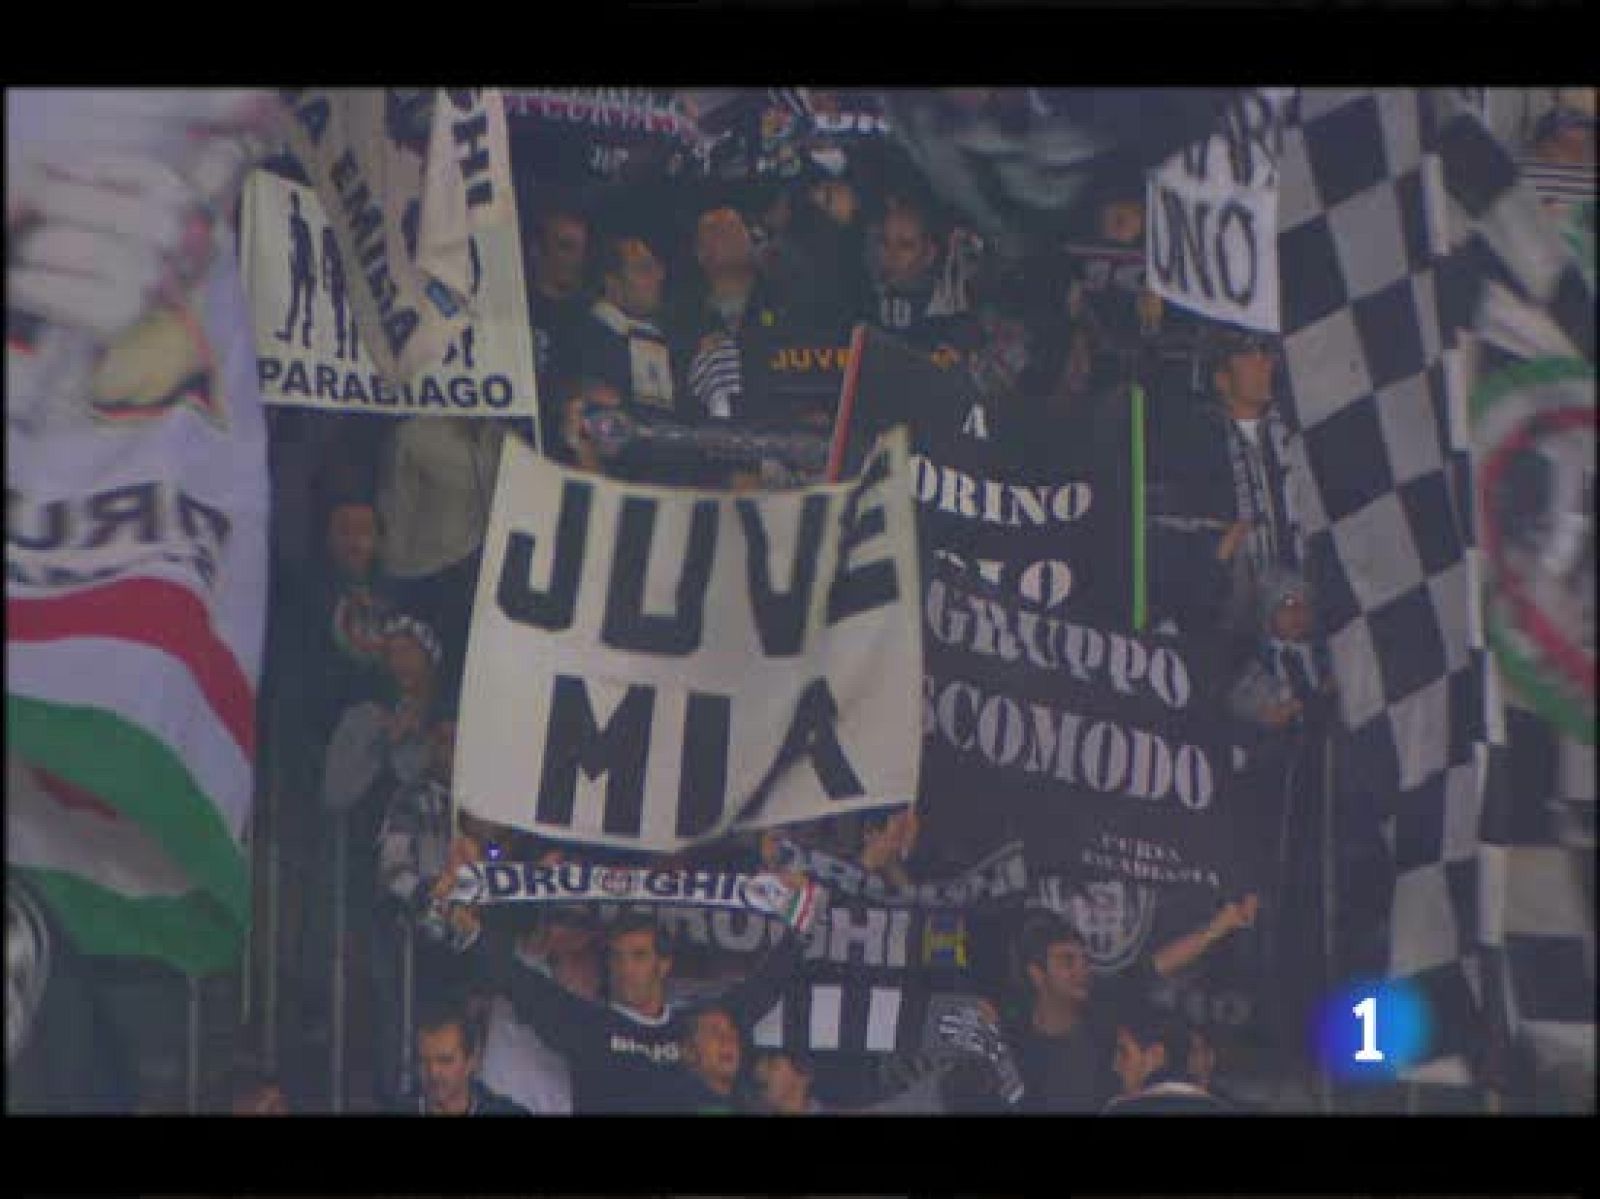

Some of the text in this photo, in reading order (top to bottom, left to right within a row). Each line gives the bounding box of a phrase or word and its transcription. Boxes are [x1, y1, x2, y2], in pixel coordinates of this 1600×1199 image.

[496, 449, 901, 658] JUVE
[928, 578, 1190, 710] GRUPPO
[535, 674, 866, 839] MIA
